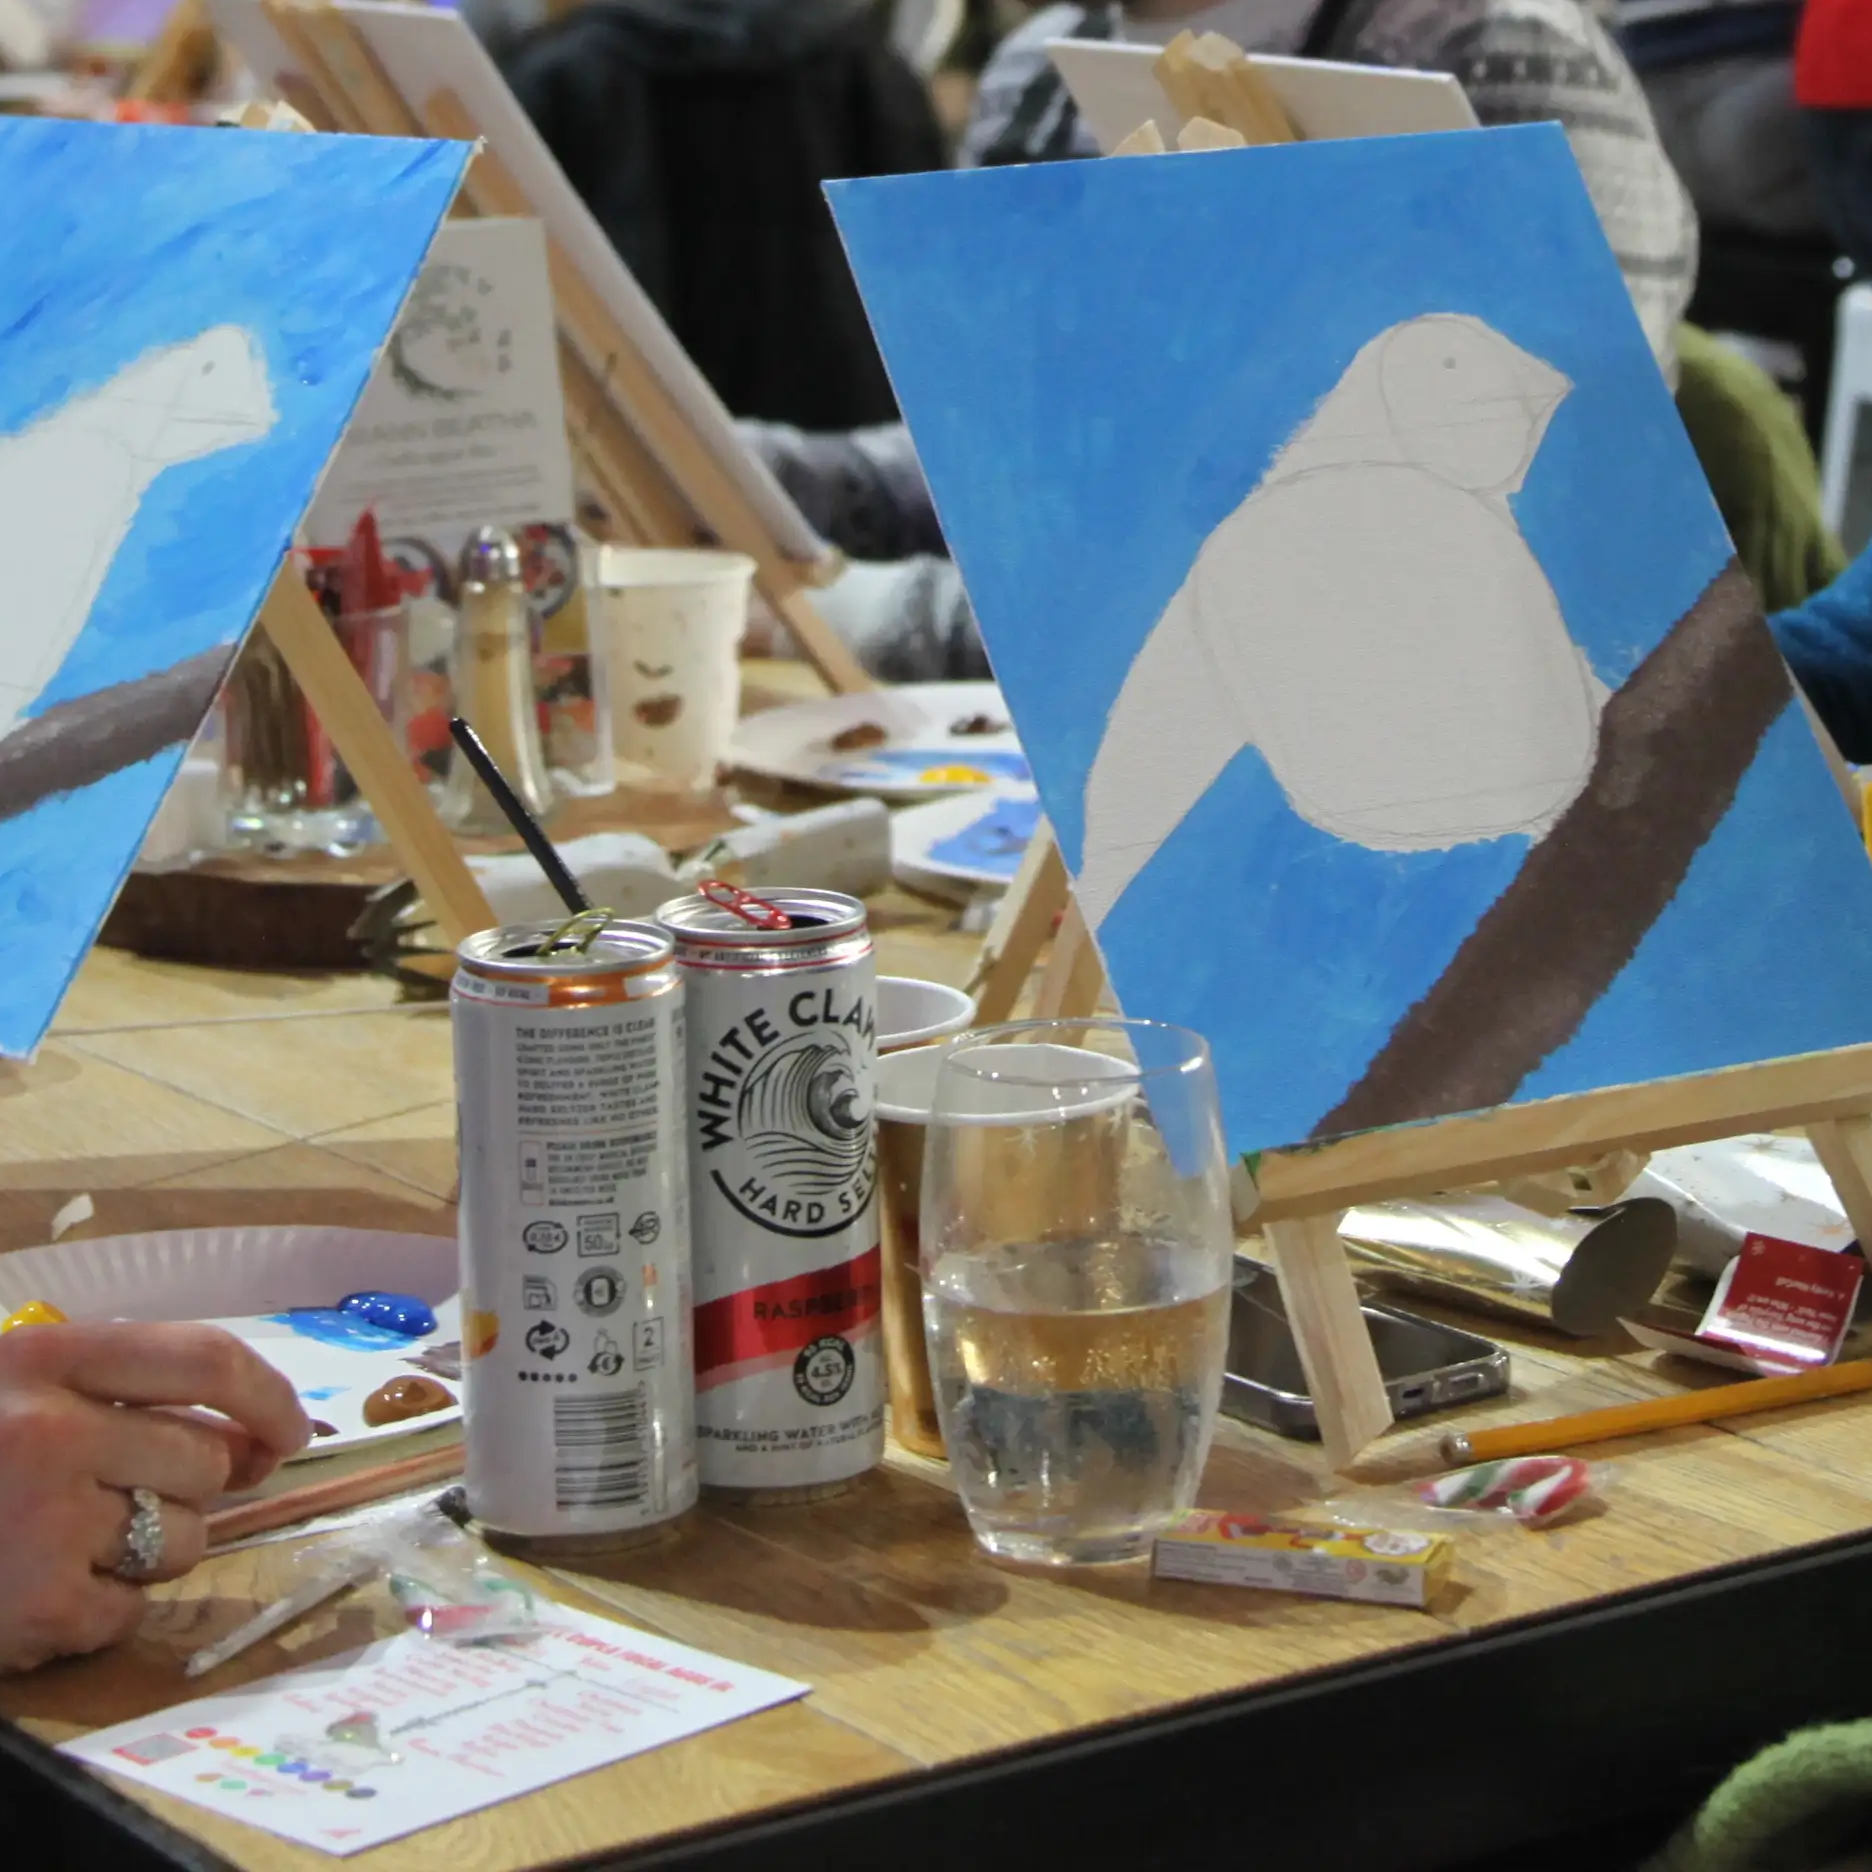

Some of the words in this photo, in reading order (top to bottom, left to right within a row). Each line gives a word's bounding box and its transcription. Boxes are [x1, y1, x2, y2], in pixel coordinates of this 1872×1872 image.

[697, 1008, 780, 1152] WHITE
[739, 1176, 826, 1225] HARD
[696, 1424, 780, 1442] SPARKLING
[783, 1424, 837, 1440] WATER
